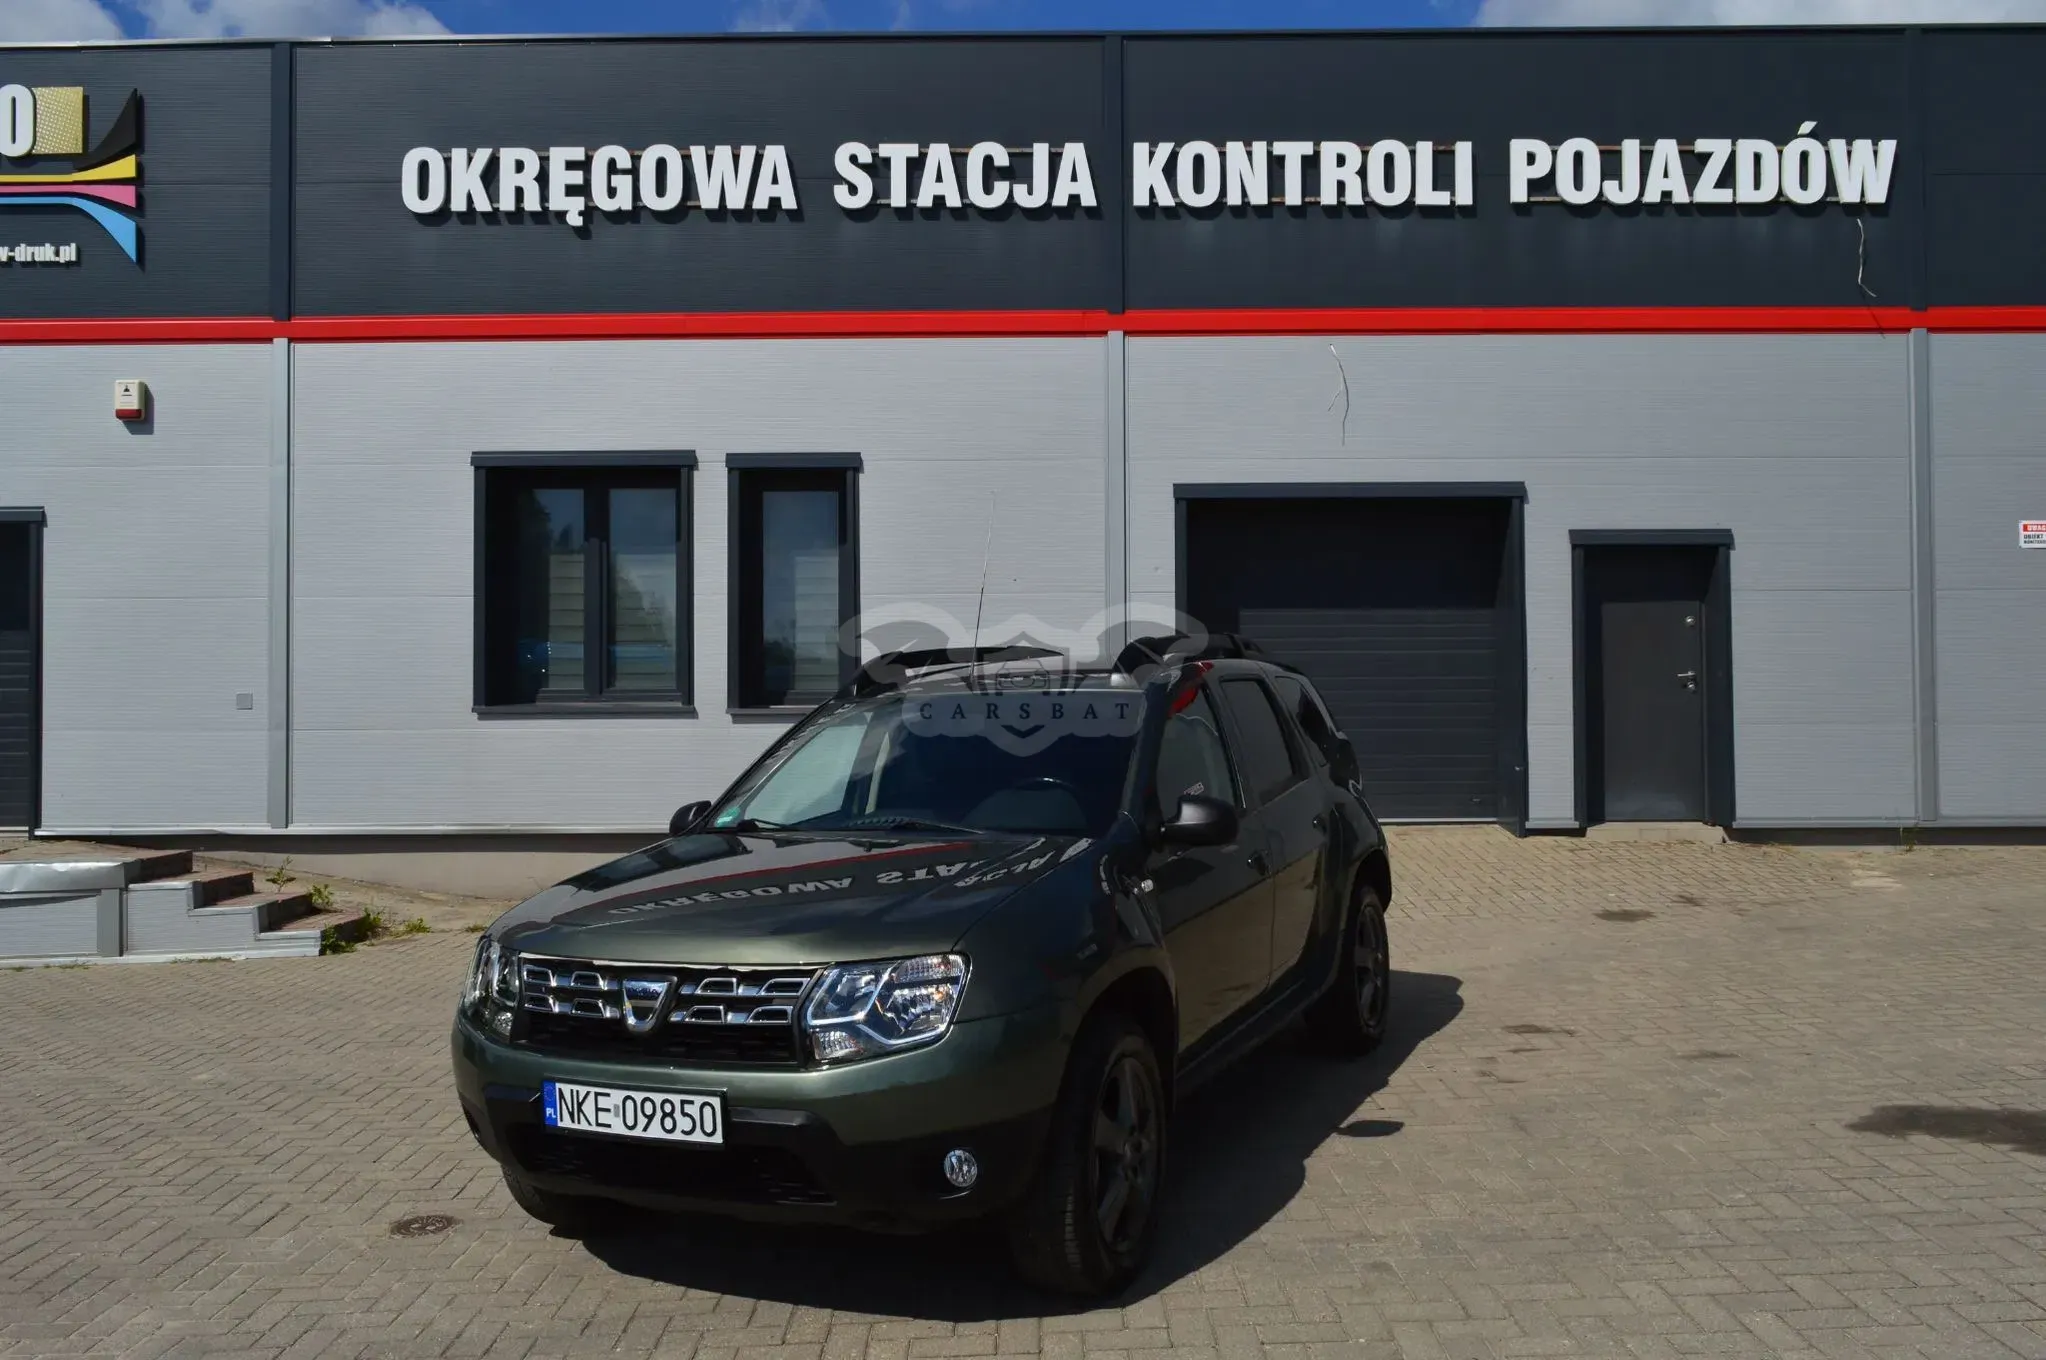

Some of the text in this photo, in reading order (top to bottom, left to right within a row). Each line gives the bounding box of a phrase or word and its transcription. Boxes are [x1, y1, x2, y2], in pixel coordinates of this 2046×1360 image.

[402, 121, 1898, 226] OKRĘGOWA STACJA KONTROLI POJAZDÓW
[546, 1107, 556, 1118] PL
[558, 1088, 718, 1137] NKE 09850
